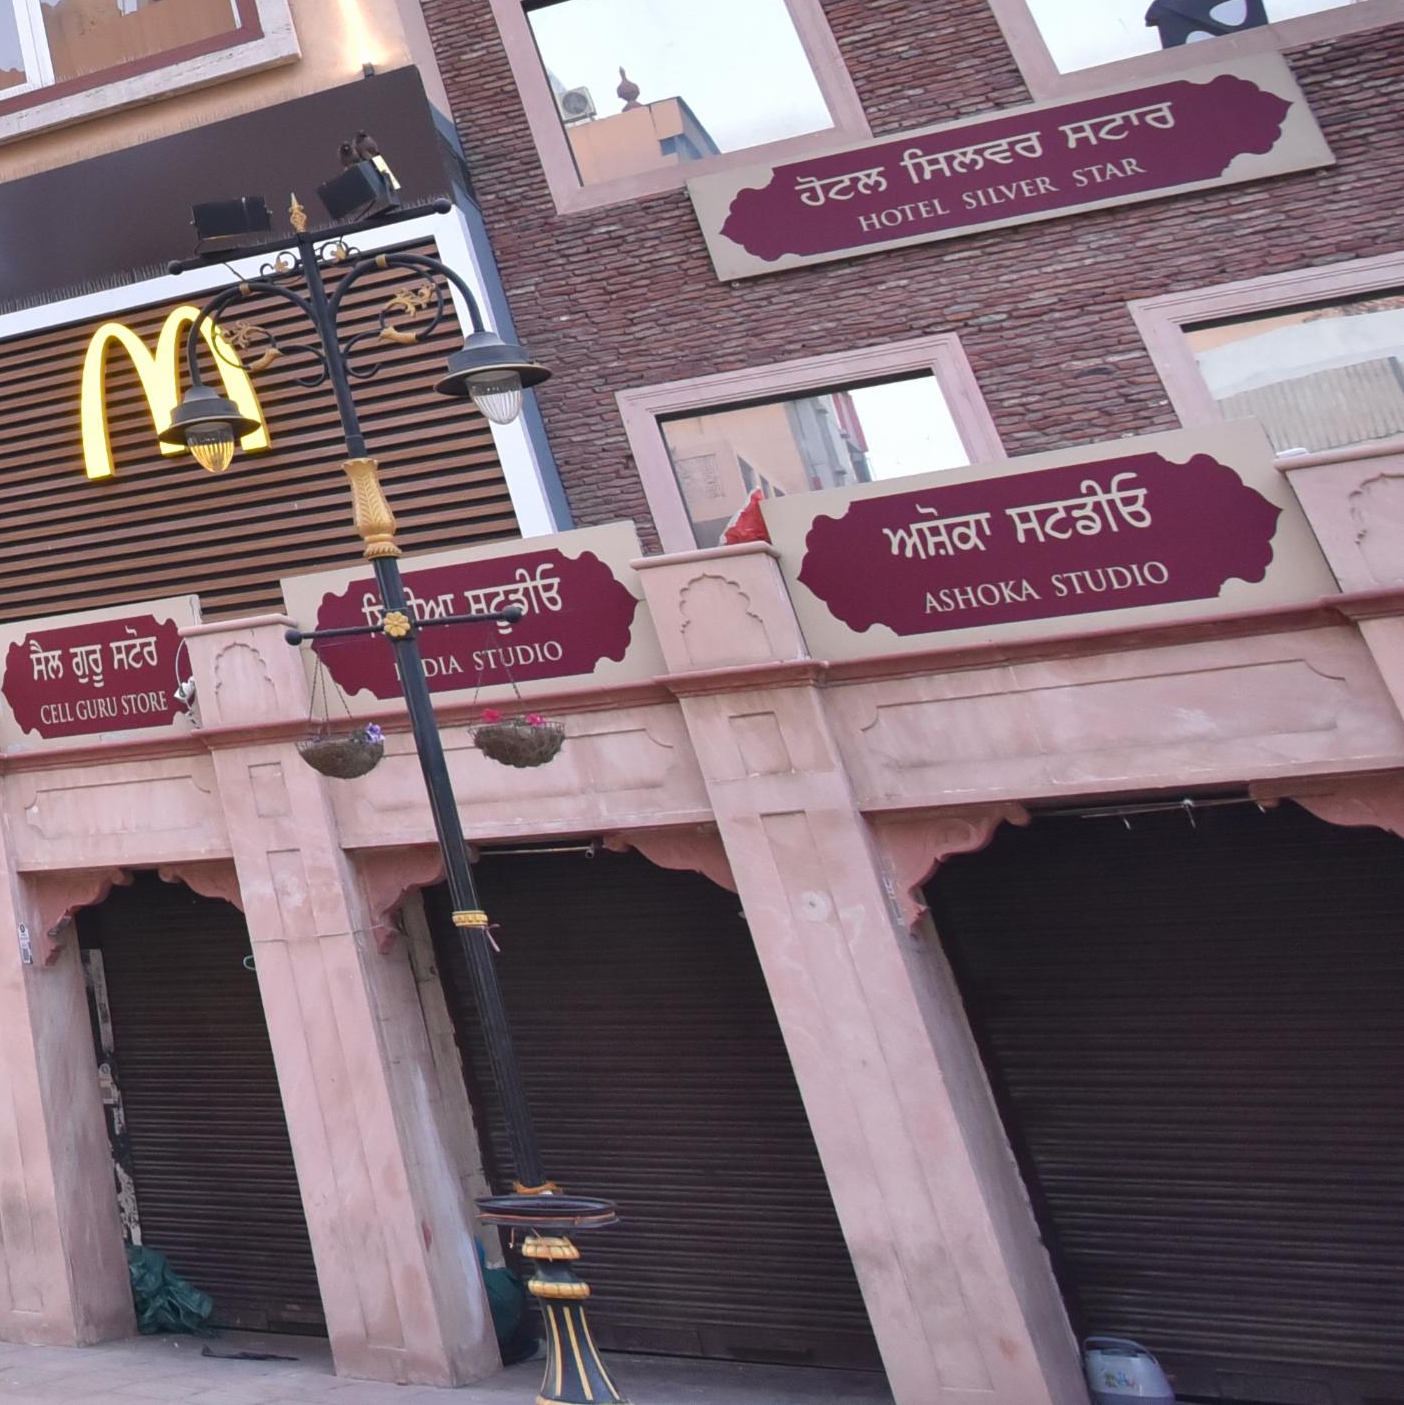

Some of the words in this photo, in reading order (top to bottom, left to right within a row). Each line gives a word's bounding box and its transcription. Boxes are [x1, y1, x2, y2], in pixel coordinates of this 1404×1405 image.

[794, 166, 888, 207] ਹੋਟਲ
[900, 131, 1043, 184] ਸਿਲਵਰ
[1058, 102, 1176, 149] ਸਟਾਰ
[858, 198, 950, 232] HOTEL
[962, 176, 1060, 210] SILVER
[1072, 157, 1147, 187] STAR
[882, 503, 992, 560] ਅਸ਼ੋਕਾ
[925, 579, 1041, 613] ASHOKA
[1051, 561, 1169, 597] STUDIO
[29, 639, 64, 681] ਸੈਲ
[69, 644, 104, 688] ਗੁਰੂ
[110, 625, 158, 671] ਸਟੋਰ
[393, 655, 464, 681] IDIA
[473, 641, 563, 672] STUDIO
[40, 703, 74, 725] CELL
[76, 697, 118, 721] GURU
[122, 690, 168, 715] STORE
